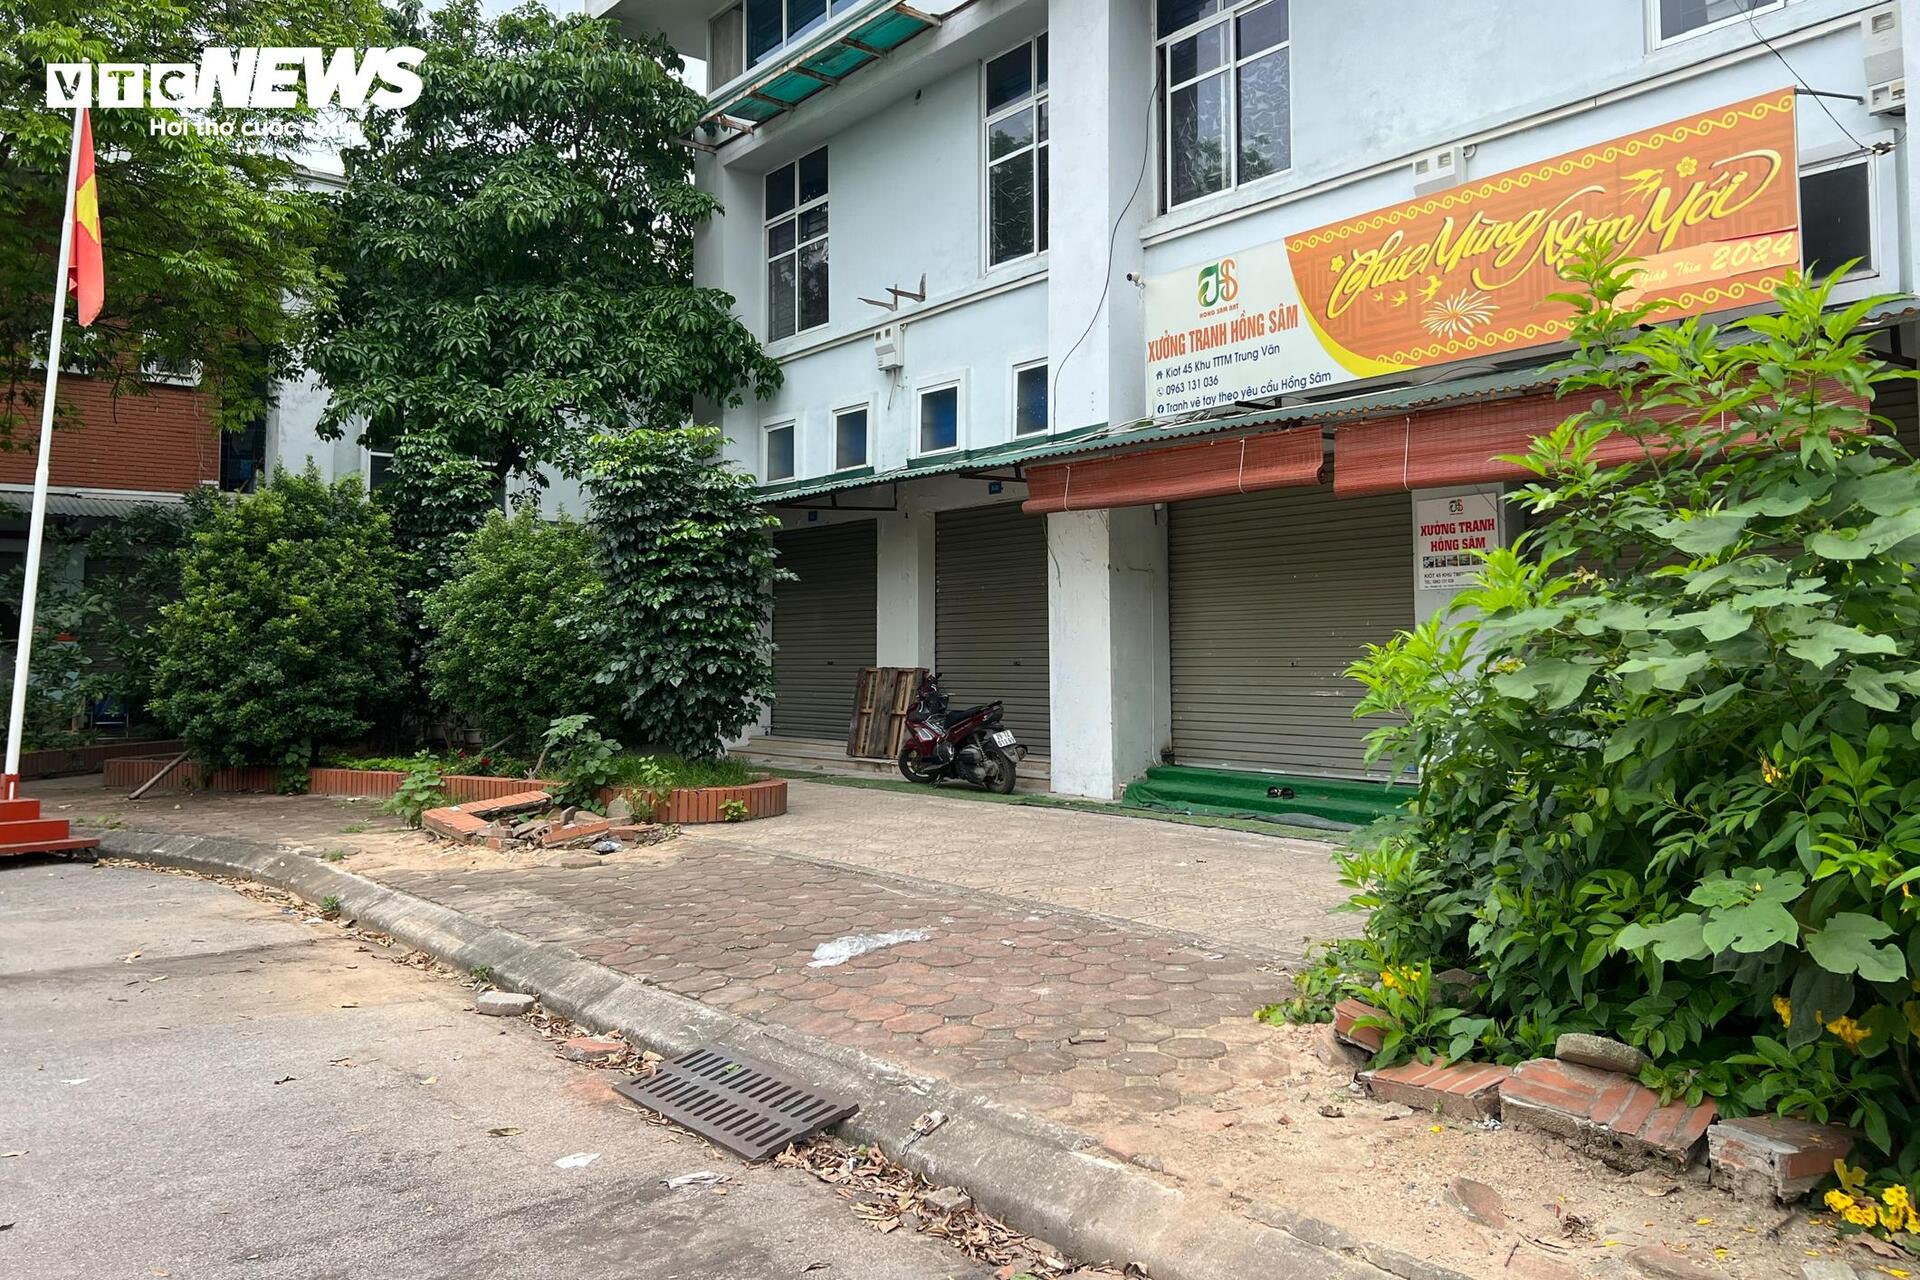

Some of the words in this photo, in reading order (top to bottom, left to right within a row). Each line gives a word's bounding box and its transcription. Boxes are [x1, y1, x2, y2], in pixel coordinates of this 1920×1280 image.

[1709, 232, 1795, 272] 2024
[1148, 330, 1186, 363] XƯỞNG
[1189, 323, 1227, 351] TRANH
[1231, 310, 1265, 343] HỒNG
[1269, 303, 1298, 334] SÂM
[1165, 366, 1181, 378] Kiot
[1183, 363, 1193, 374] 45
[1194, 360, 1211, 372] Khu
[1213, 354, 1232, 368] TTTM
[1235, 350, 1259, 362] Trung
[1261, 343, 1280, 356] Văn
[1166, 382, 1185, 395] 0963
[1188, 379, 1200, 391] 131
[1203, 375, 1219, 388] 036
[1167, 400, 1188, 413] Tranh
[1203, 395, 1216, 407] tay
[1219, 391, 1239, 402] theo
[1241, 385, 1258, 400] yêu
[1260, 379, 1279, 394] cầu
[1281, 375, 1307, 390] Hồng
[1309, 371, 1332, 385] Sâm
[1458, 518, 1495, 533] TRANH
[1462, 535, 1486, 549] SÂM
